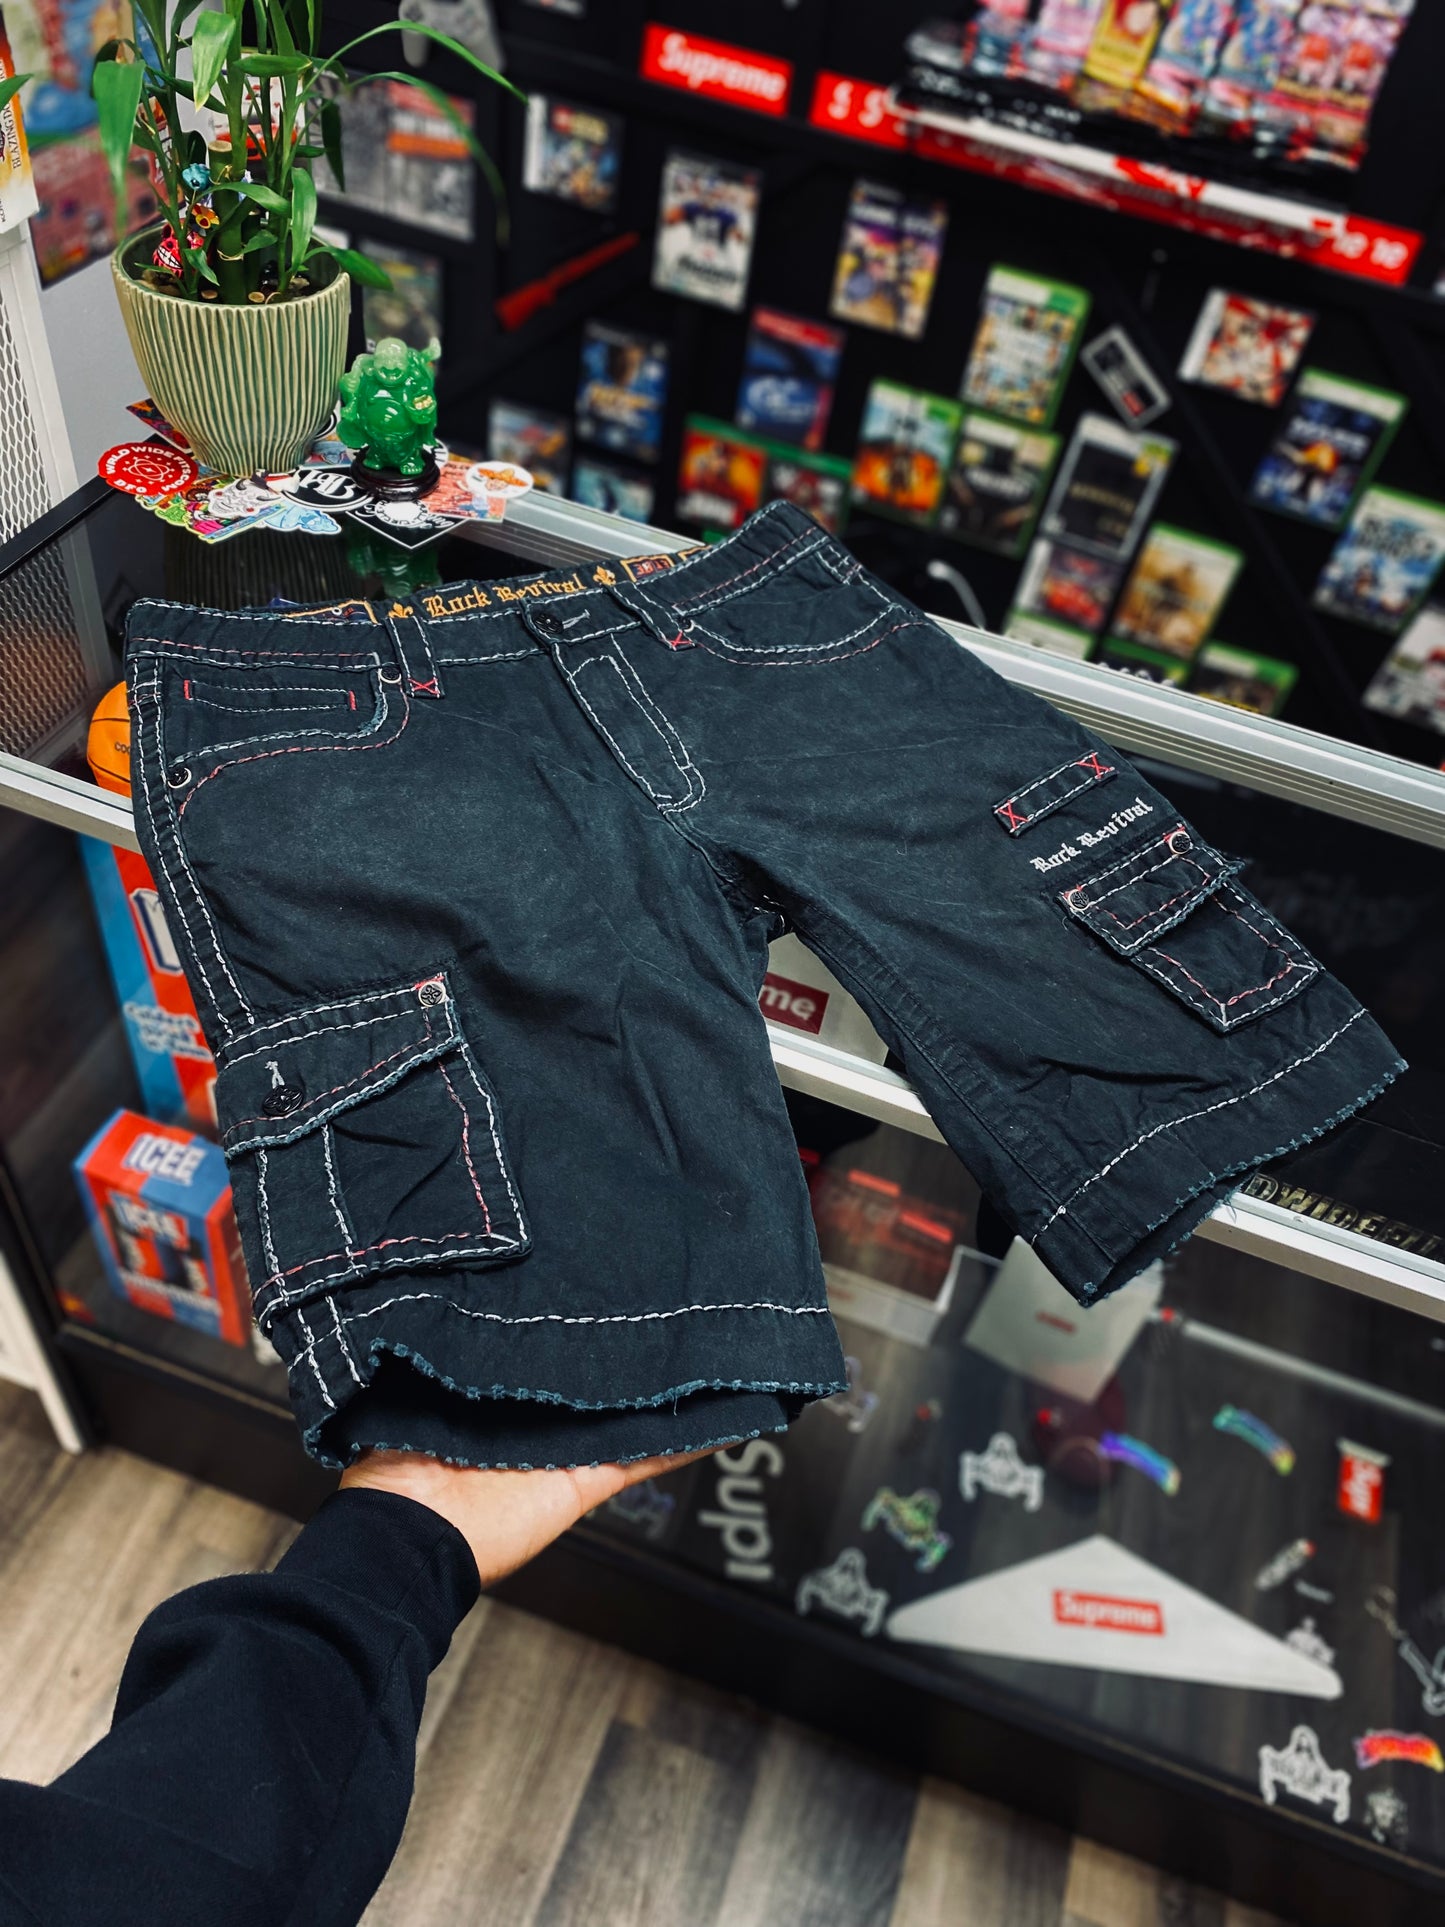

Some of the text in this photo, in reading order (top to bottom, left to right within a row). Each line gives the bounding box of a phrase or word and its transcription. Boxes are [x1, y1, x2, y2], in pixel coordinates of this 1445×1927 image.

[657, 32, 787, 101] Supreme
[4, 117, 21, 169] BLAZING
[131, 446, 175, 459] WIDE
[113, 479, 148, 493] DFO
[422, 573, 587, 617] Rock Revival
[1029, 796, 1153, 873] Rock Revival
[121, 1133, 206, 1187] ICEE
[1061, 1591, 1157, 1628] Supreme
